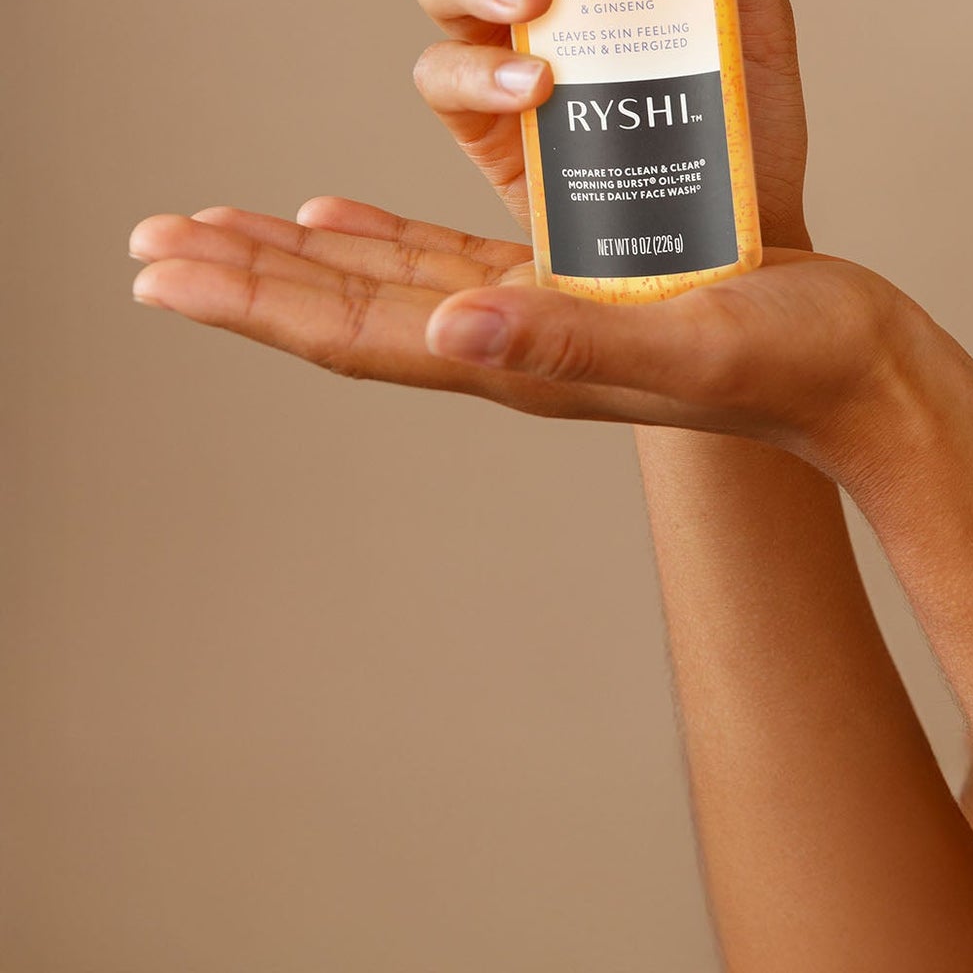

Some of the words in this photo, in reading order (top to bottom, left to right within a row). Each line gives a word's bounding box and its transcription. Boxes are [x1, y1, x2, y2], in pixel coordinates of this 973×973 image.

[581, 5, 589, 15] &
[594, 0, 655, 14] GINSENG
[552, 30, 596, 42] LEAVES
[600, 28, 632, 40] SKIN
[637, 22, 690, 38] FEELING
[556, 45, 596, 57] CLEAN
[600, 44, 609, 55] &
[615, 37, 688, 54] ENERGIZED
[561, 168, 606, 178] COMPARE
[608, 168, 623, 177] TO
[624, 165, 658, 176] CLEAN
[660, 164, 668, 174] &
[568, 179, 615, 190] MORNING
[658, 172, 702, 186] OIL-FREE
[570, 192, 605, 202] GENTLE
[607, 191, 638, 201] DAILY
[640, 189, 666, 200] FACE
[597, 238, 614, 257] NET
[615, 237, 630, 256] WT
[631, 237, 638, 255] 8
[639, 236, 652, 255] OZ
